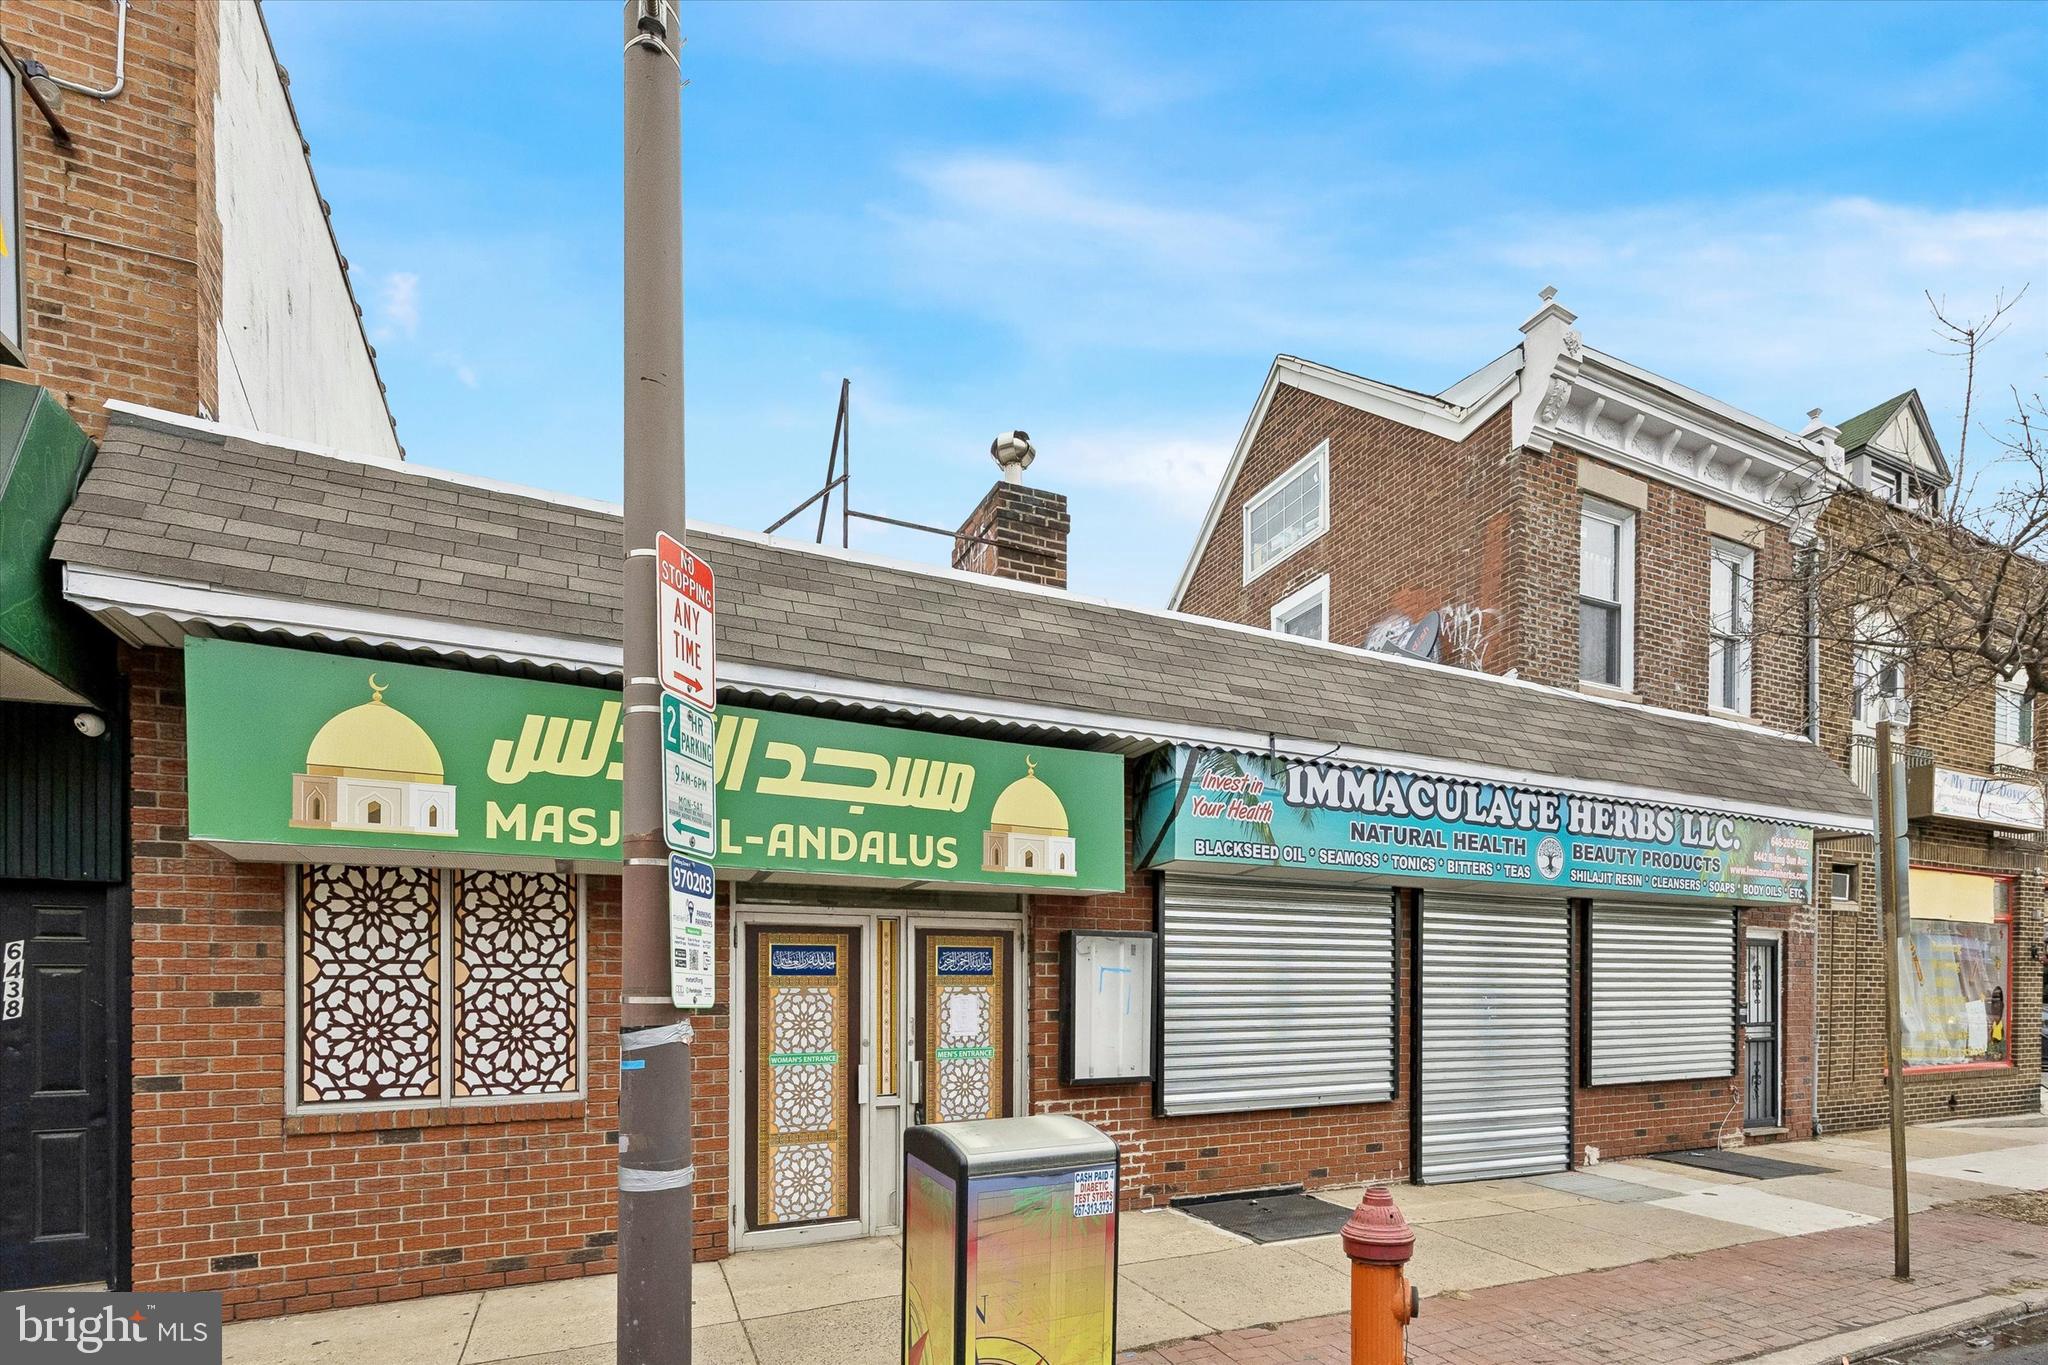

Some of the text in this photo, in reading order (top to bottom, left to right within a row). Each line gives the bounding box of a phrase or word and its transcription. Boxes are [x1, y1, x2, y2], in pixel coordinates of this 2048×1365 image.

[681, 550, 694, 575] NO
[662, 560, 711, 609] STOPPING
[674, 597, 700, 635] ANY
[674, 630, 701, 670] TIME
[667, 705, 704, 744] 2 HR
[681, 732, 712, 762] PARKING
[756, 742, 976, 813] مسجد
[1202, 769, 1264, 794] Invest in
[1193, 797, 1272, 822] Your Health
[1286, 763, 1741, 849] IMMACULATE HERBS LLC.
[486, 800, 958, 868] MASJ L-ANDALUS
[1350, 822, 1526, 856] NATURAL HEALTH
[1195, 840, 1531, 878] BLACKSEED OIL SEAMOSS TONICS BITTERS TEAS
[1572, 843, 1721, 872] BEAUTY PRODUCTS
[674, 866, 712, 894] 970203
[1570, 869, 1806, 899] SHILAJIT RESIN CLEANSERS SOAPS BODY OILS ETC.
[6, 943, 21, 1017] 6438
[771, 1056, 803, 1064] WOMAN'S
[937, 1049, 993, 1058] MEN'S ENTRANCE
[1075, 1170, 1114, 1183] CASH PAID 4
[1080, 1181, 1109, 1192] DIABETIC
[1074, 1190, 1114, 1204] TEST STRIPS
[1074, 1201, 1112, 1216] 267-313-3731
